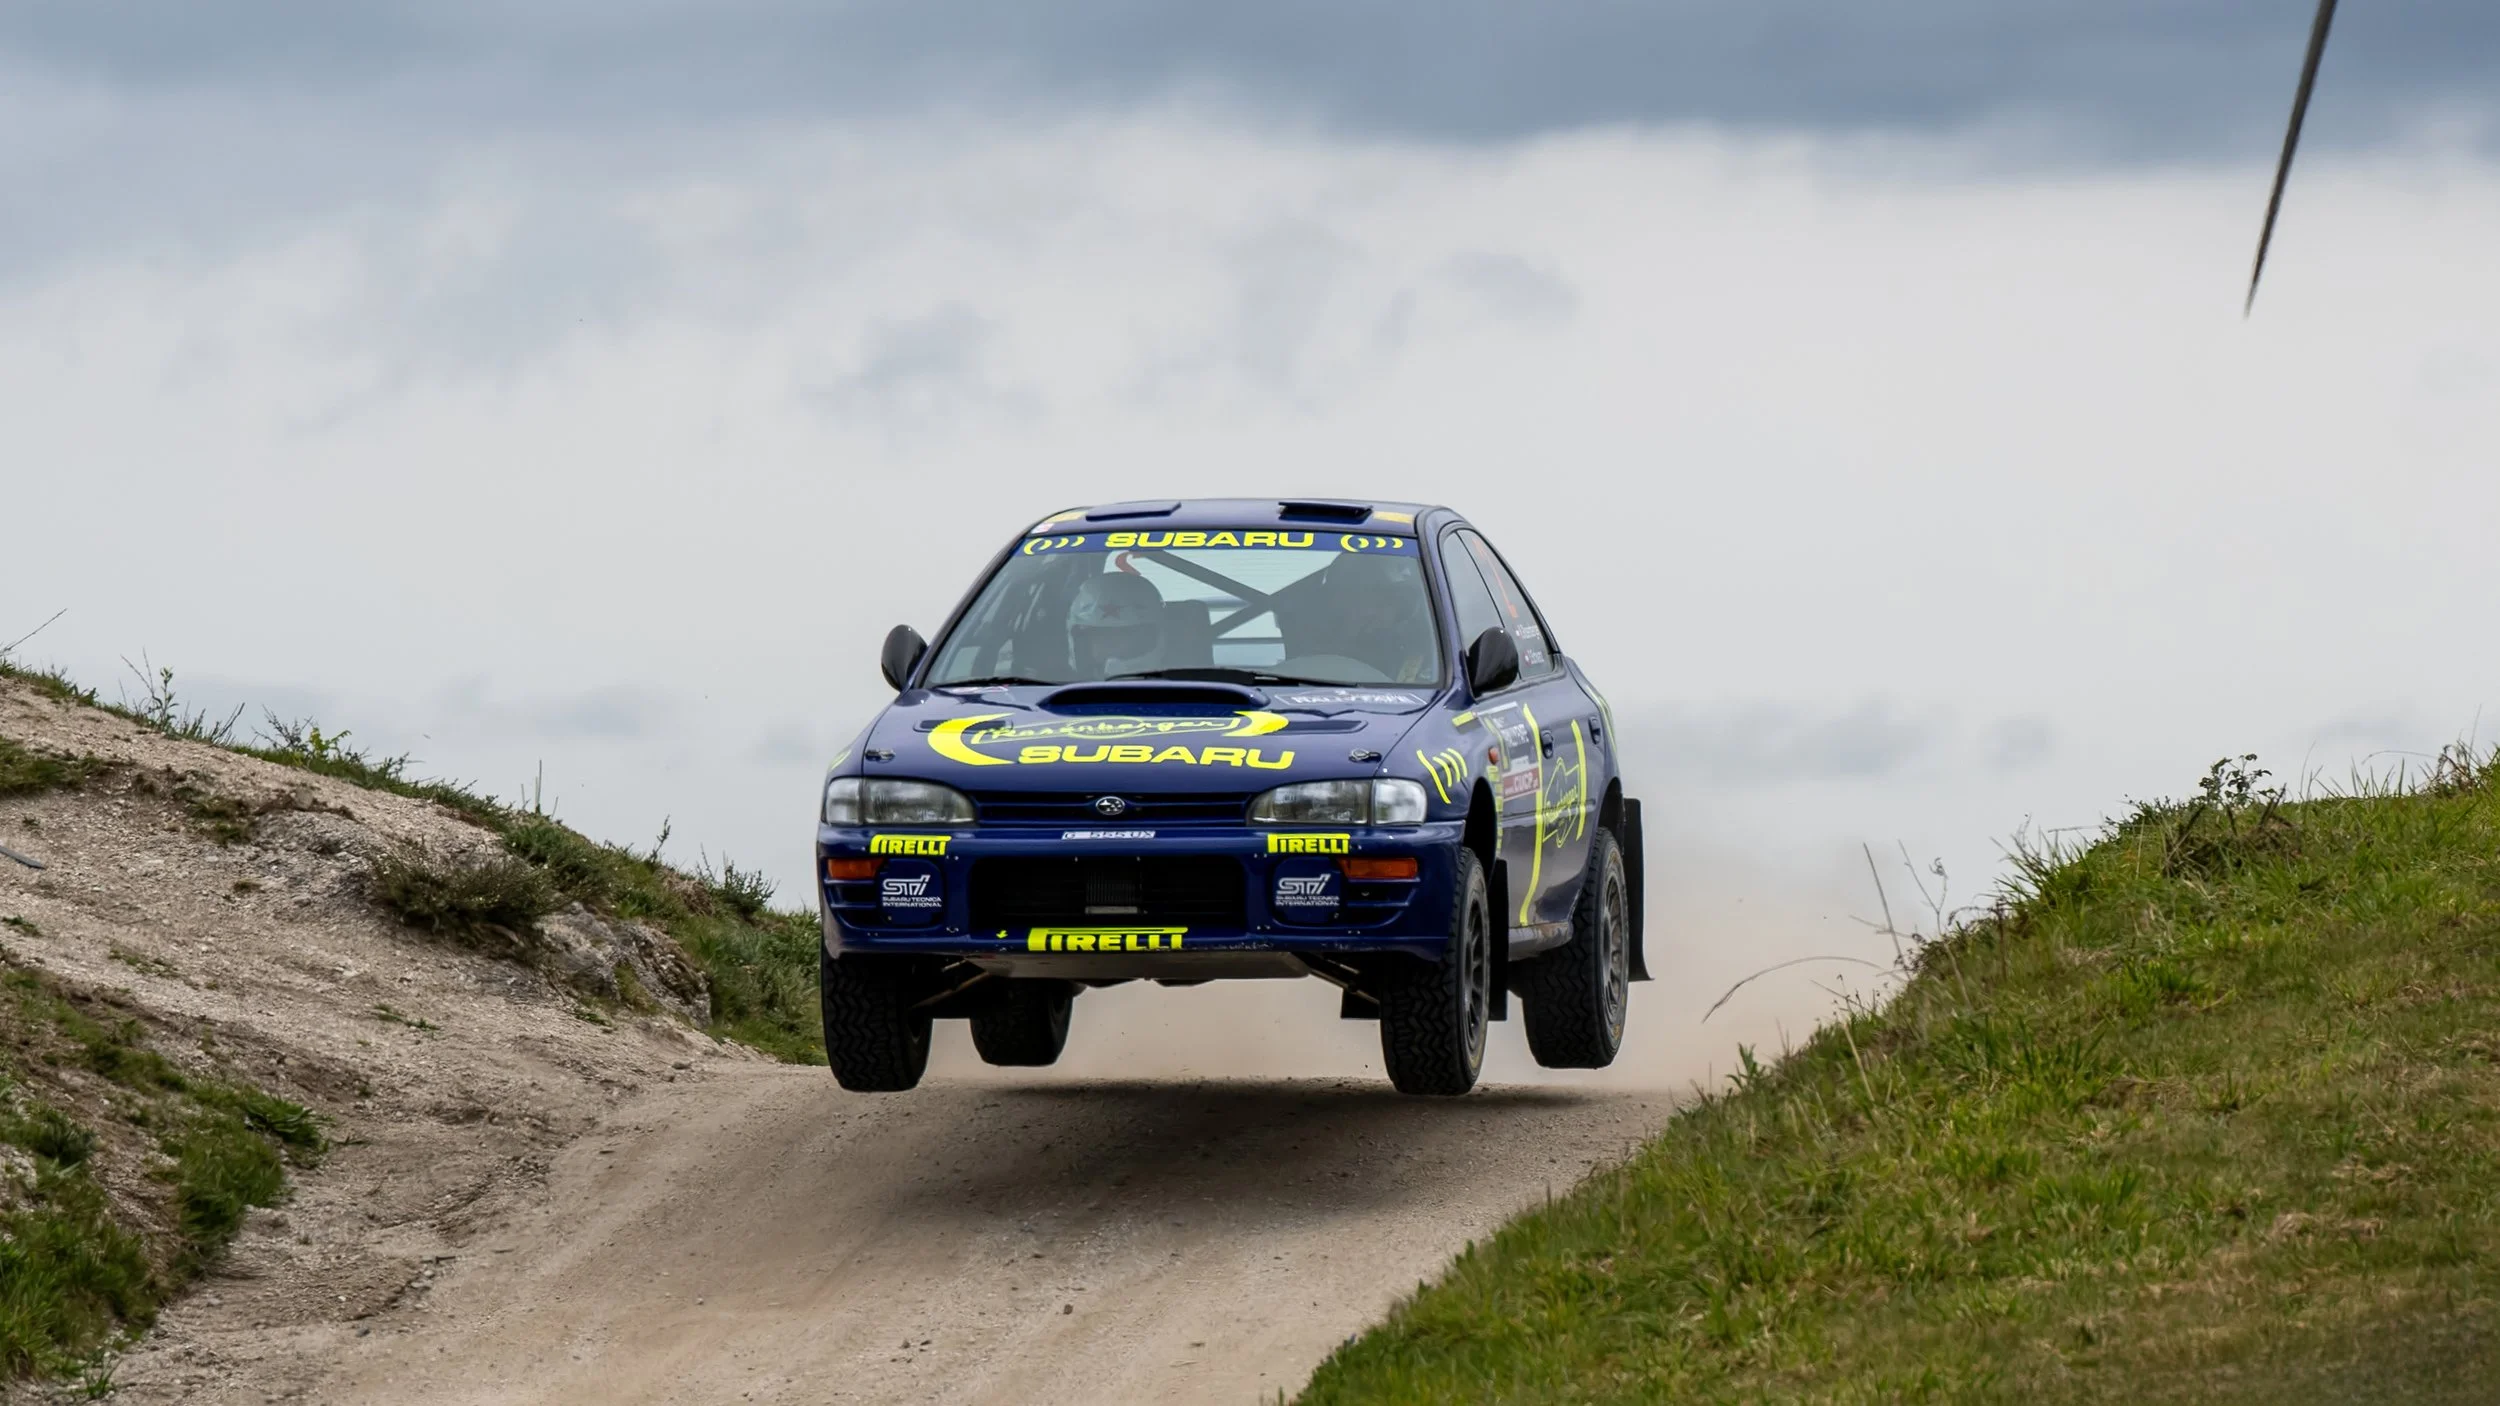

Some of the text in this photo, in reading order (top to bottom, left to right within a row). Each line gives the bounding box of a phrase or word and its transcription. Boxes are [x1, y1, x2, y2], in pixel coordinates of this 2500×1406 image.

[1105, 532, 1314, 548] SUBARU
[1018, 745, 1295, 769] SUBARU
[870, 834, 951, 855] PIRELLI
[1267, 833, 1350, 854] PIRELLI
[1028, 927, 1188, 951] PIRELLI
